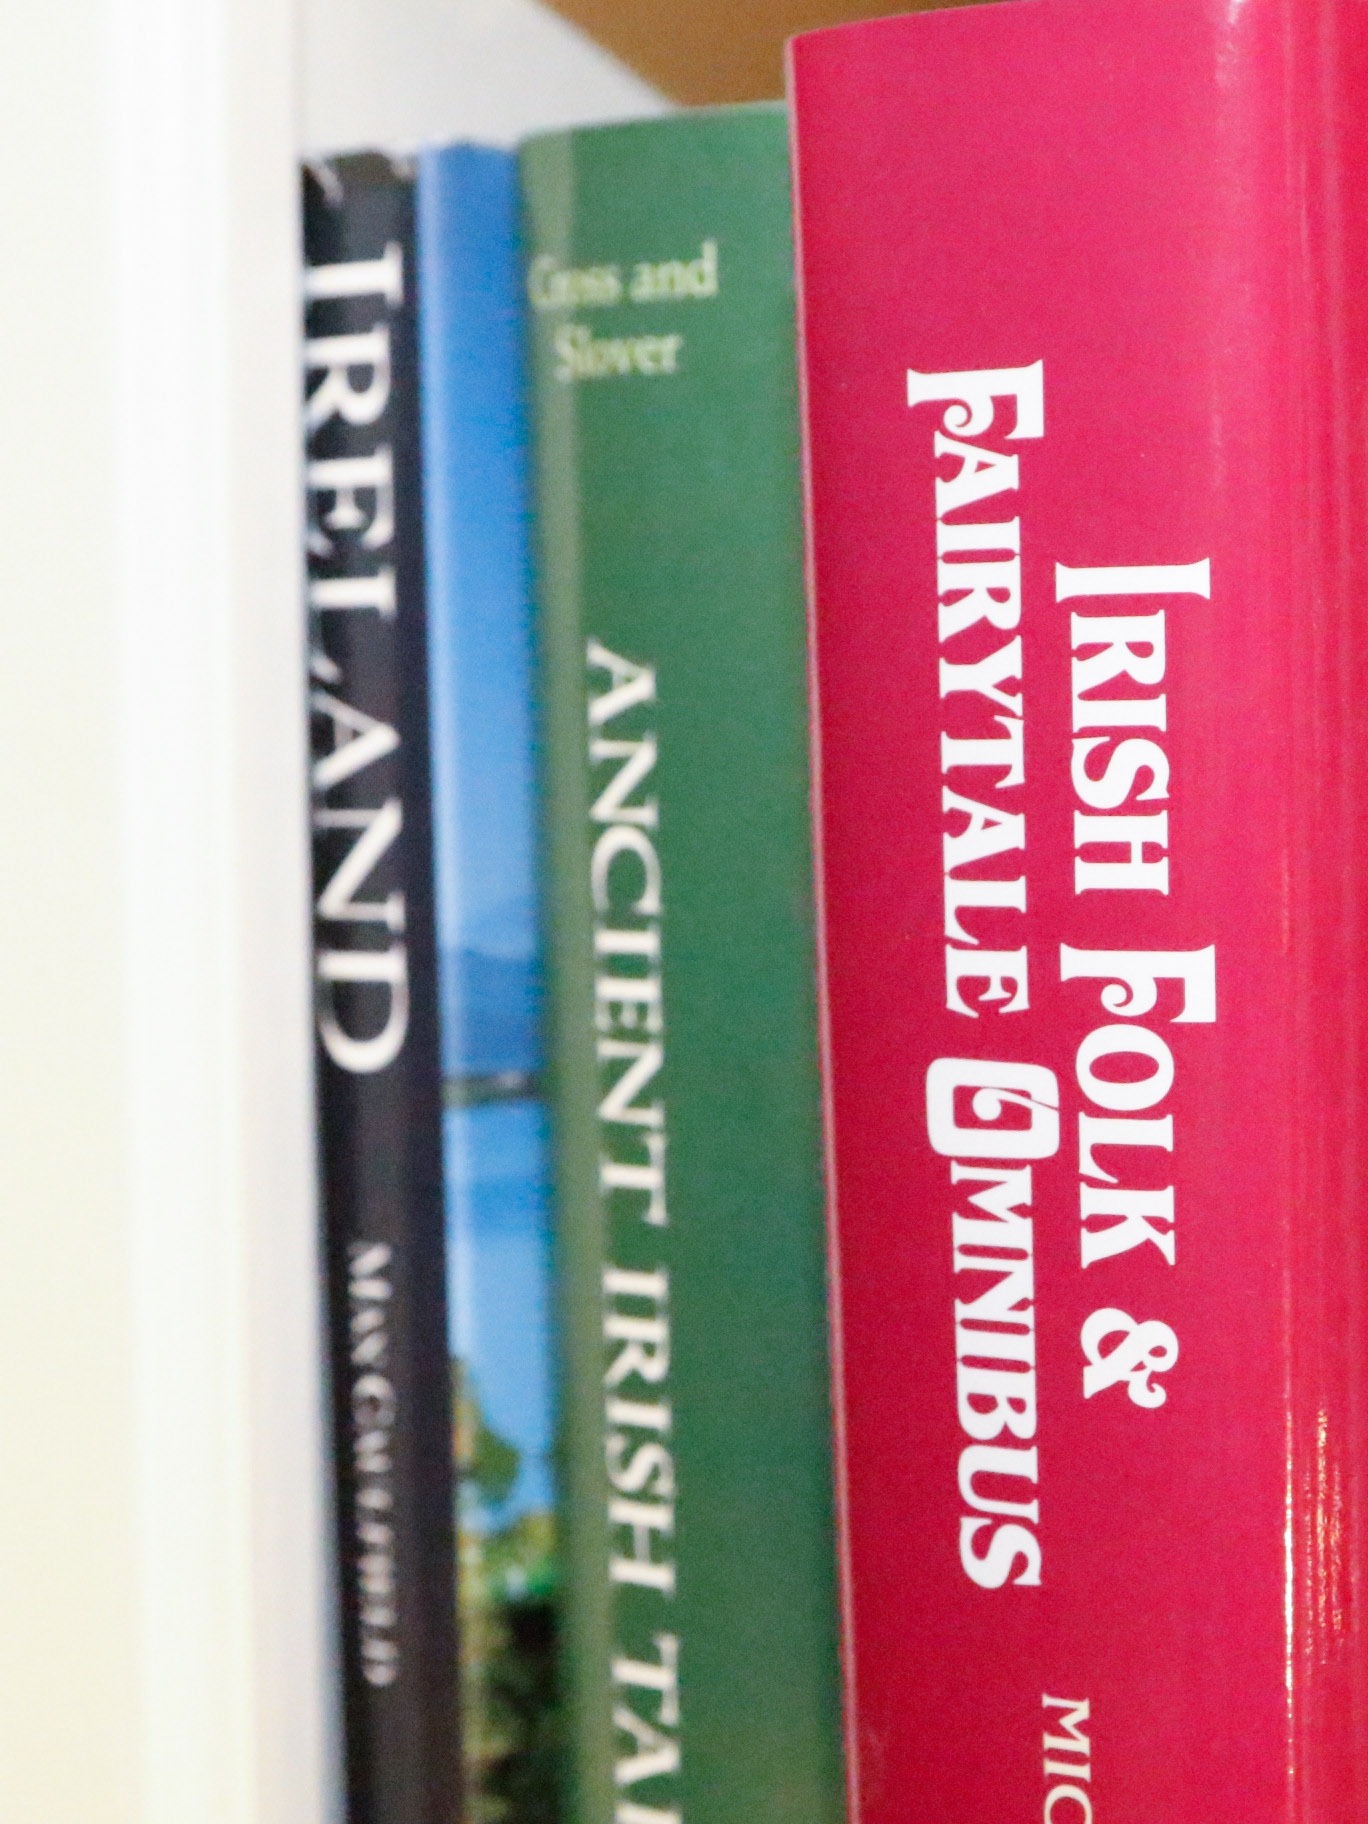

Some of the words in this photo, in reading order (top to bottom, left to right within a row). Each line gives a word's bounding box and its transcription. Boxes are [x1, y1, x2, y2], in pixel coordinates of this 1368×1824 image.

[629, 237, 718, 302] and
[302, 240, 410, 1075] IRELAND
[906, 360, 1044, 1018] FAIRYTALE
[1054, 557, 1211, 896] IRISH
[586, 637, 668, 1226] ANCIENT
[1059, 944, 1216, 1268] FOLK
[602, 1267, 676, 1595] IRISH
[926, 1057, 1061, 1590] OMNIBUS
[1080, 1307, 1179, 1409] &
